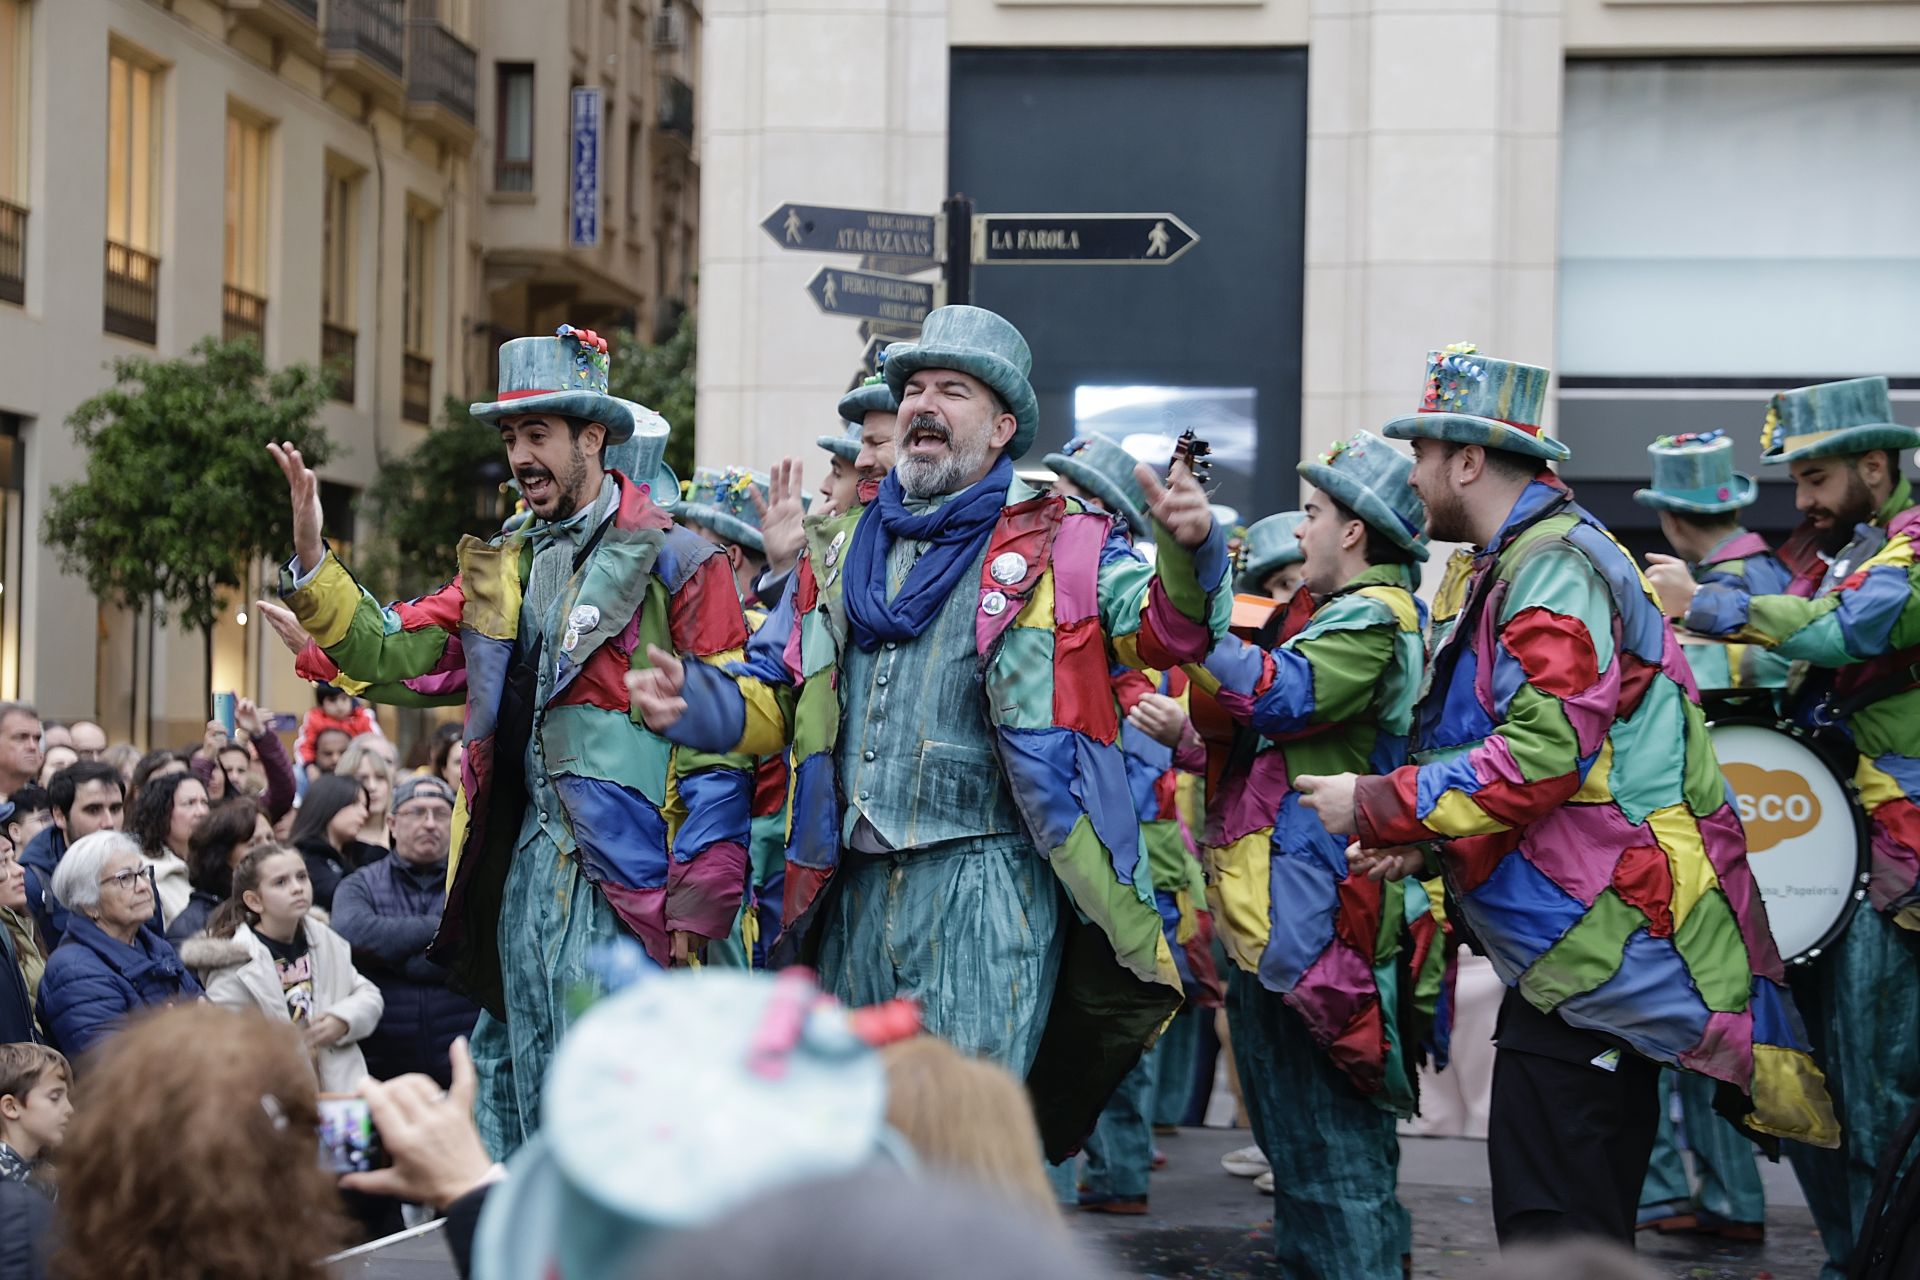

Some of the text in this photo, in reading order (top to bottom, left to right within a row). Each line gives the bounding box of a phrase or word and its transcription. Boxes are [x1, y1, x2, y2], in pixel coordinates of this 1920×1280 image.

[867, 214, 929, 233] MERCADO DE
[836, 227, 930, 256] ATARAZANAS
[991, 229, 1080, 250] LA FAROLA
